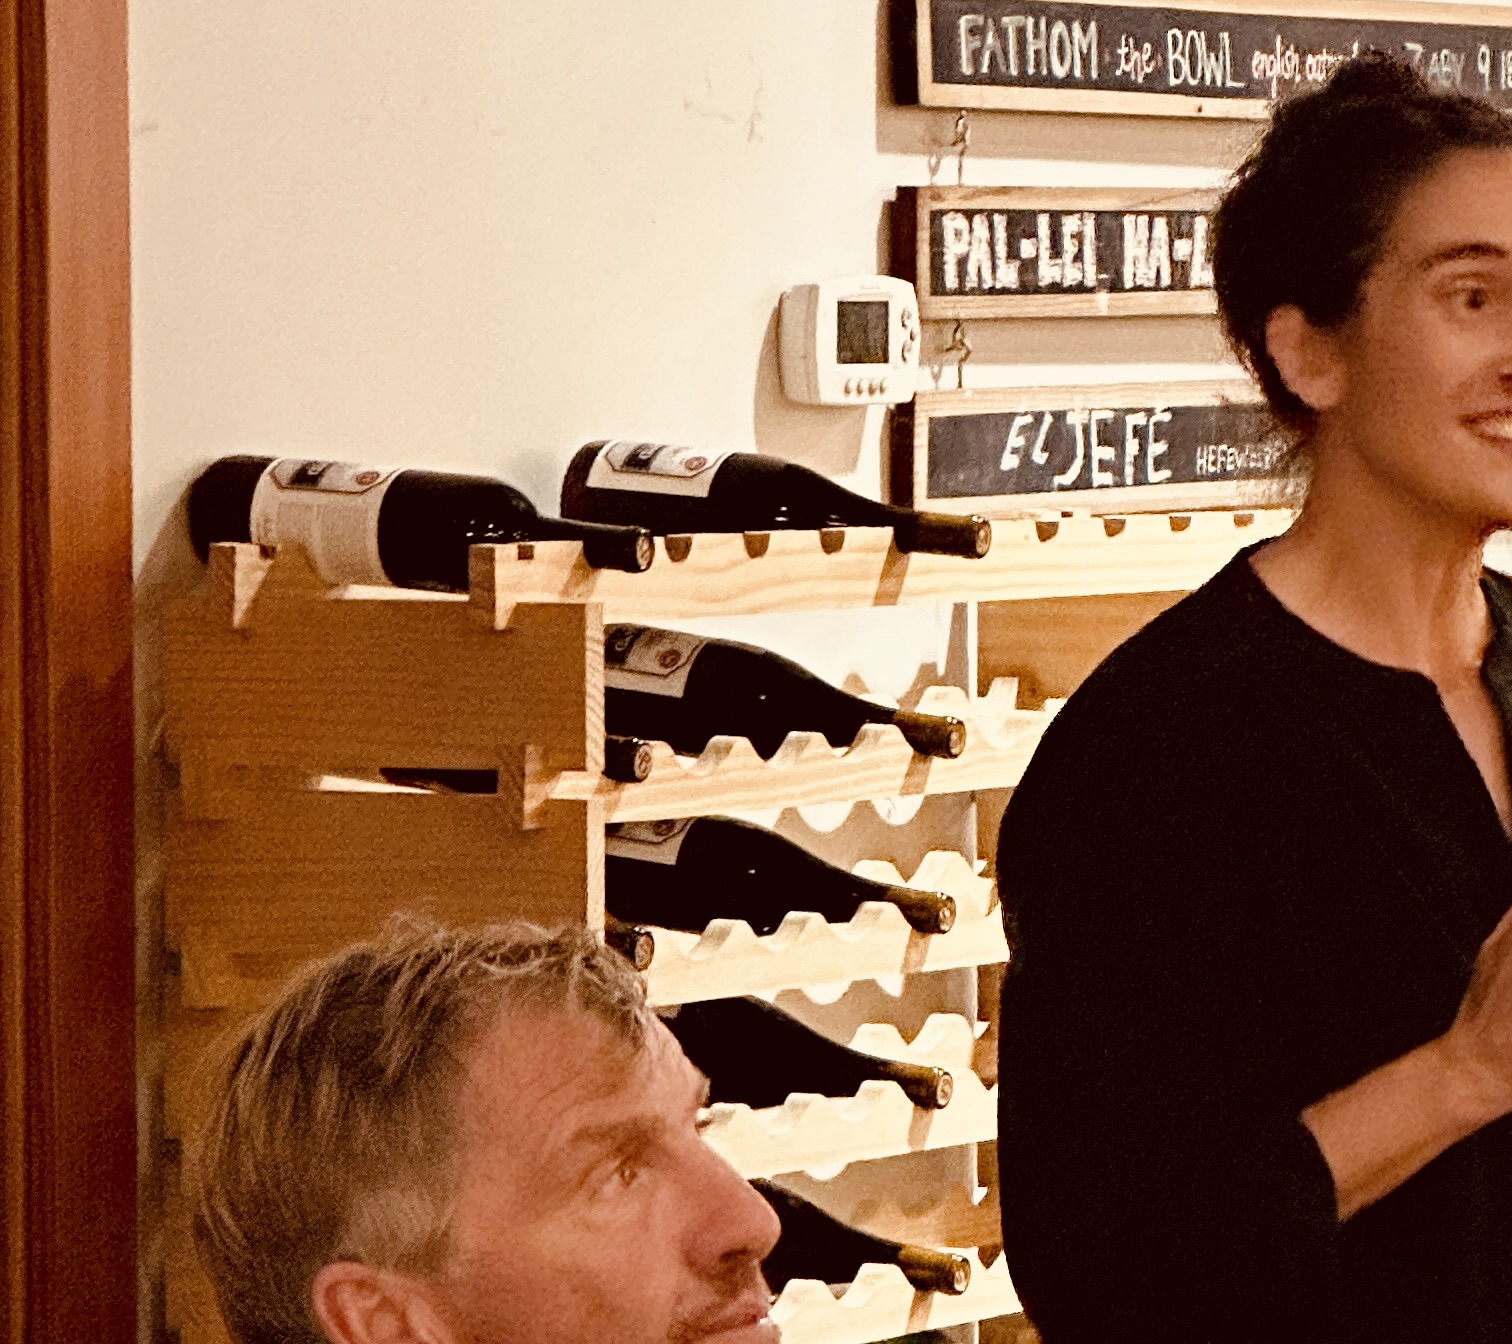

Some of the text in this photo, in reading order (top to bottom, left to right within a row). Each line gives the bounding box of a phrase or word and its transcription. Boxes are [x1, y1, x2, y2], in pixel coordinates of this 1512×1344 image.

[958, 14, 1099, 80] FATHOM
[1116, 31, 1154, 83] the
[1166, 28, 1249, 88] BOWL
